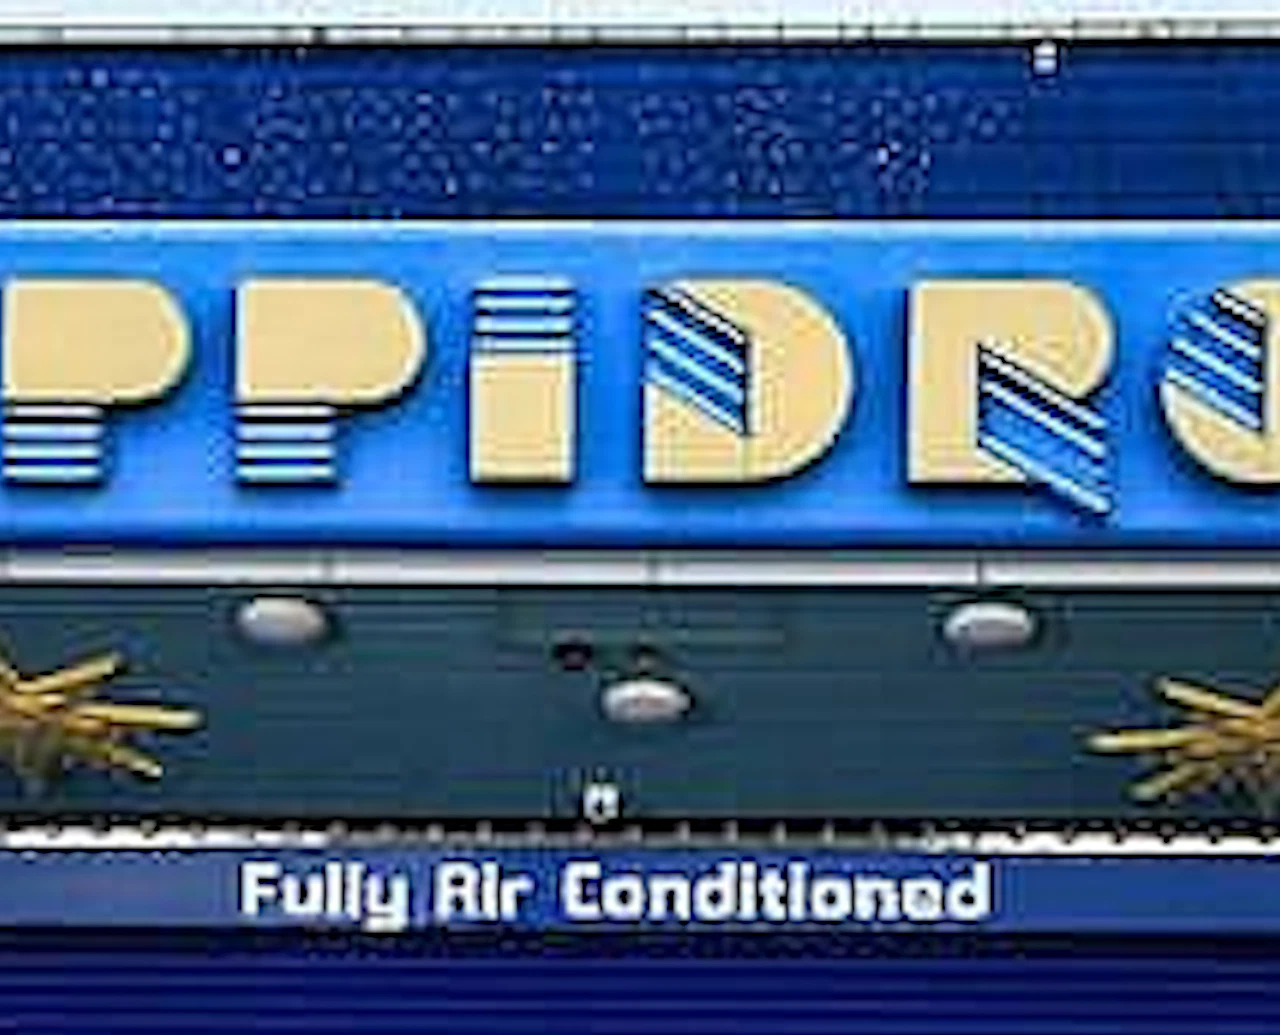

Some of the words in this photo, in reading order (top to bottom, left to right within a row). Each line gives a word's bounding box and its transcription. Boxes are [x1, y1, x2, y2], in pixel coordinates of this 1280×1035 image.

[240, 859, 410, 932] Fully
[435, 859, 534, 922] Air
[560, 859, 994, 922] Conditioned
